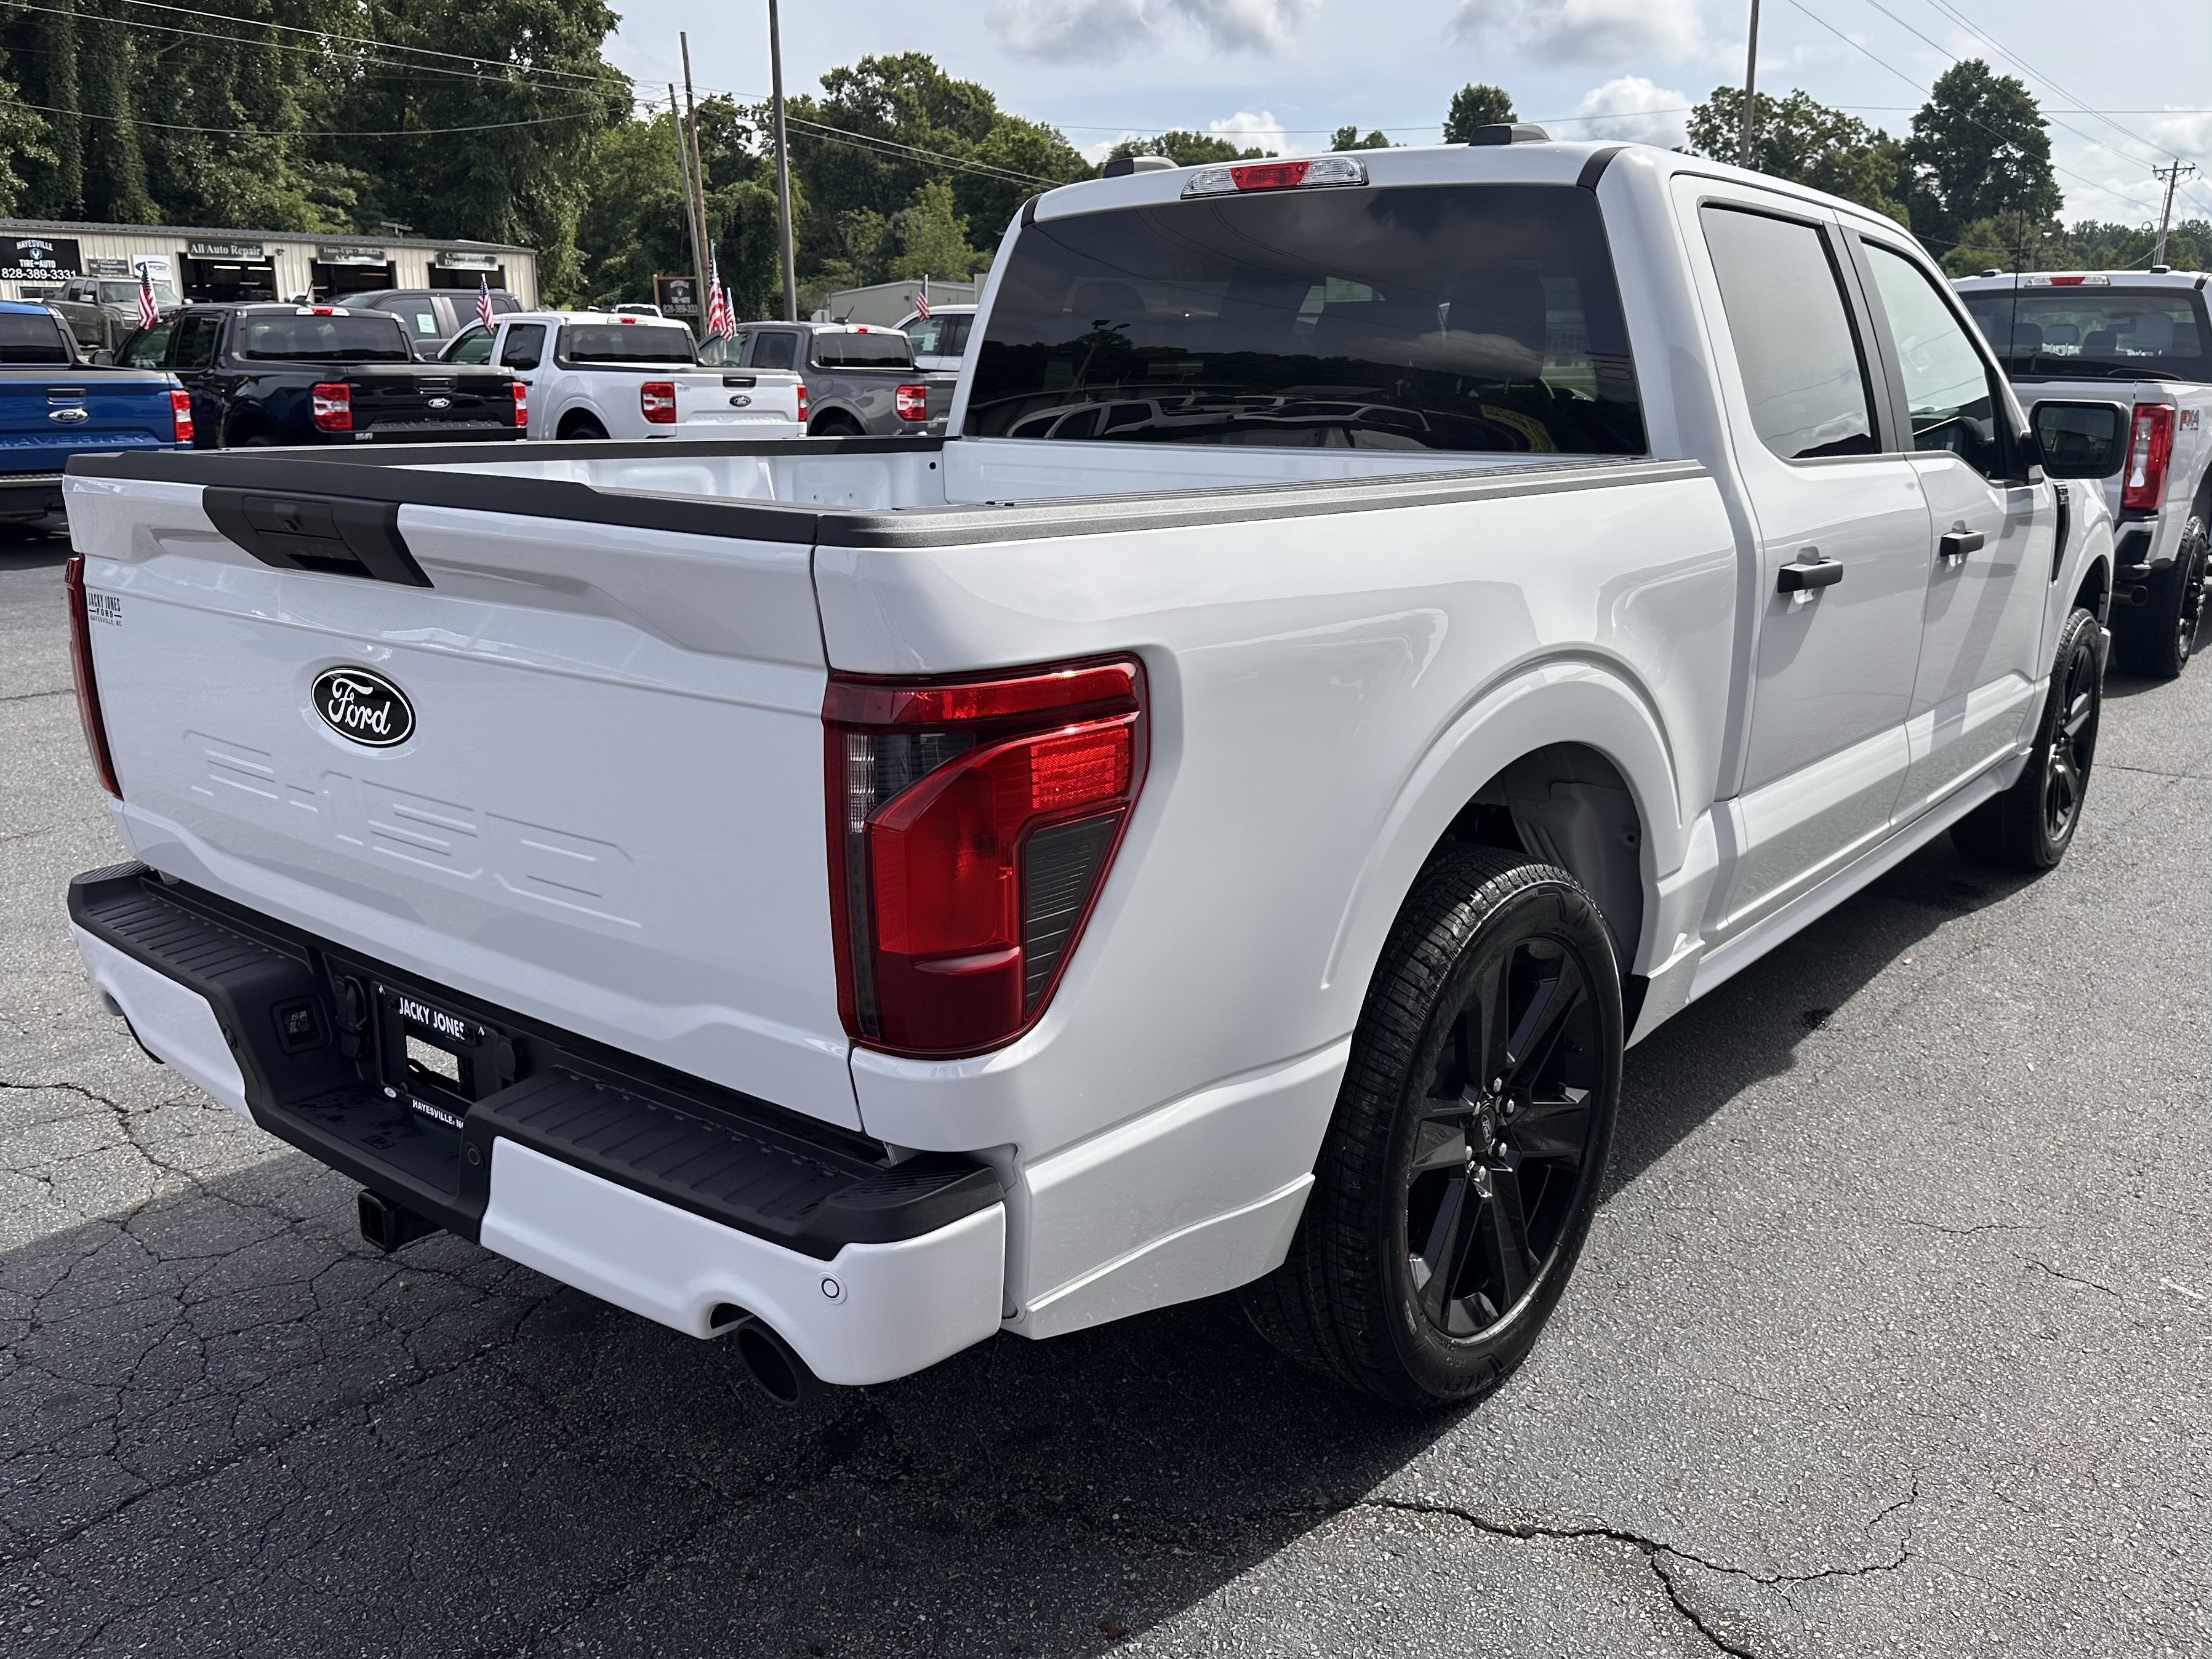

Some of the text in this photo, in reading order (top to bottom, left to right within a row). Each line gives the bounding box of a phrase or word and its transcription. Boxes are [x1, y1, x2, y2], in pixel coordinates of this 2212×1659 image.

[16, 239, 54, 252] HAYESVILLE
[190, 243, 261, 258] All Auto Repair
[1, 268, 76, 279] 828-389-3331
[89, 593, 120, 612] JACKY JONES
[97, 608, 113, 618] FORD
[328, 678, 391, 735] Ford
[399, 997, 465, 1040] JACKY JONES
[412, 1098, 455, 1125] HAYESVILLE,
